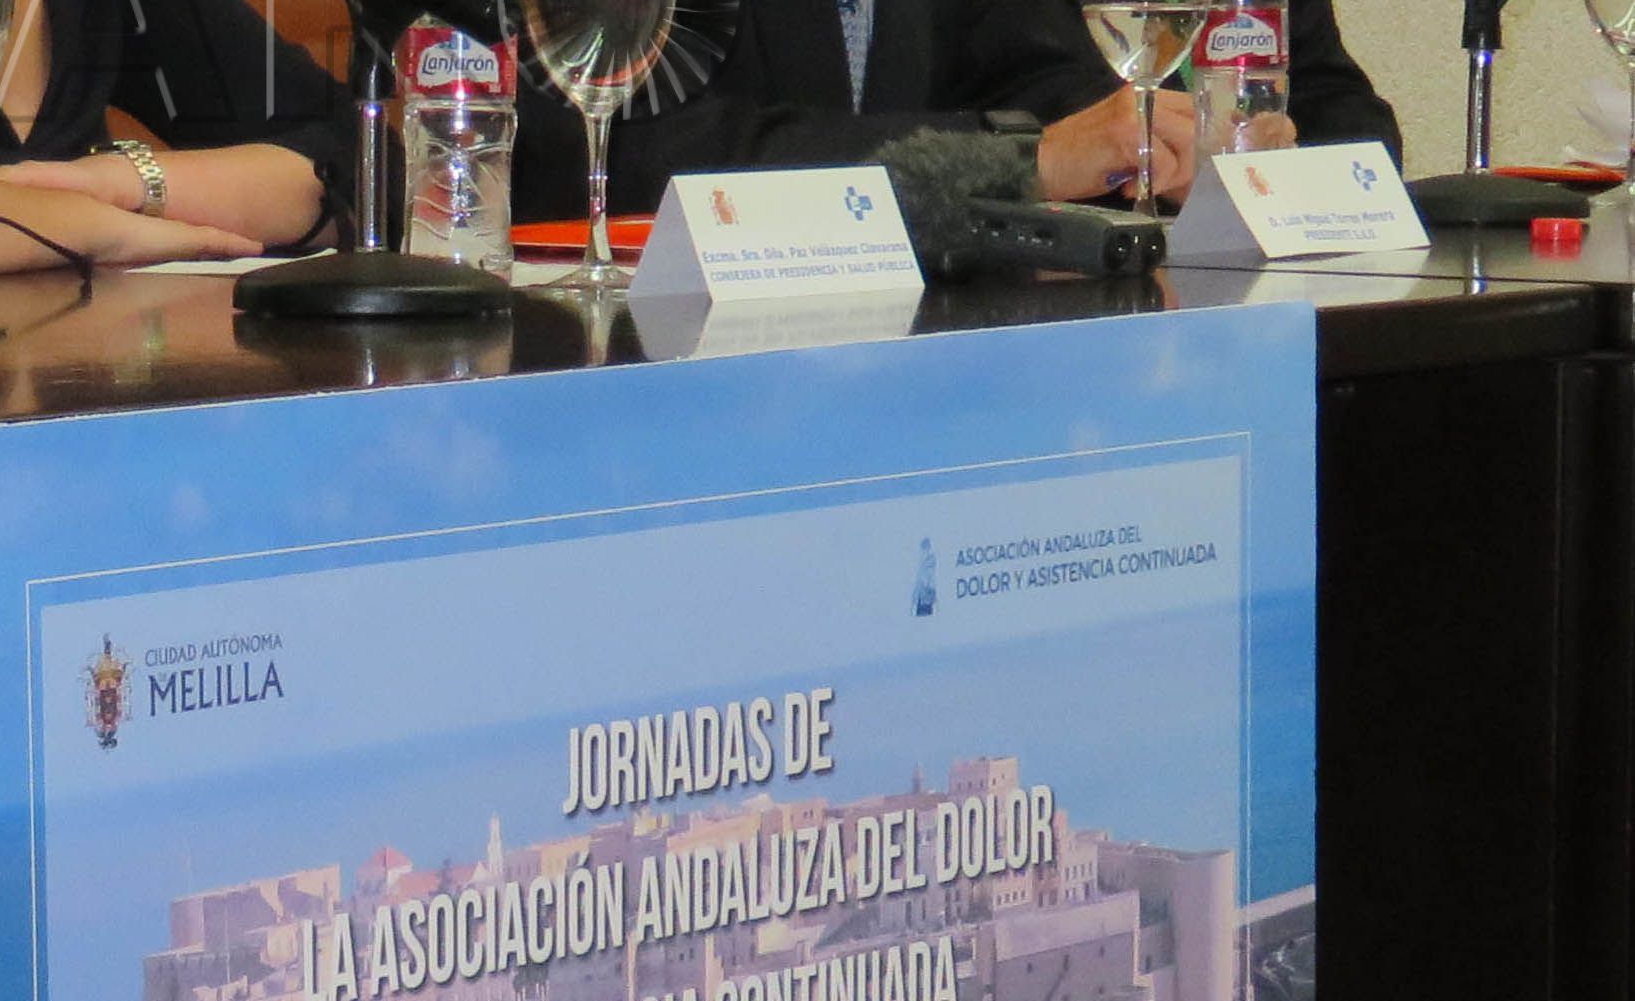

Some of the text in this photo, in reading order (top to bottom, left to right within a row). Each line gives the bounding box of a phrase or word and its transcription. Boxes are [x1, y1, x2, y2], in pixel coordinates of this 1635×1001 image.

[421, 53, 495, 75] Lanjarón
[955, 542, 1218, 600] DOLOR Y ASISTENCIA CONTINUADA
[956, 524, 1143, 567] ASOCIACIÓN ANDALUZA DEL
[144, 633, 283, 668] CIUDAD AUTÓNOMA
[148, 660, 285, 718] MELILLA
[563, 686, 834, 815] JORNADAS DE
[302, 784, 1054, 1001] LA ASOCIACIÓN ANDALUZA DEL DOLOR
[714, 935, 960, 1001] INUADA
